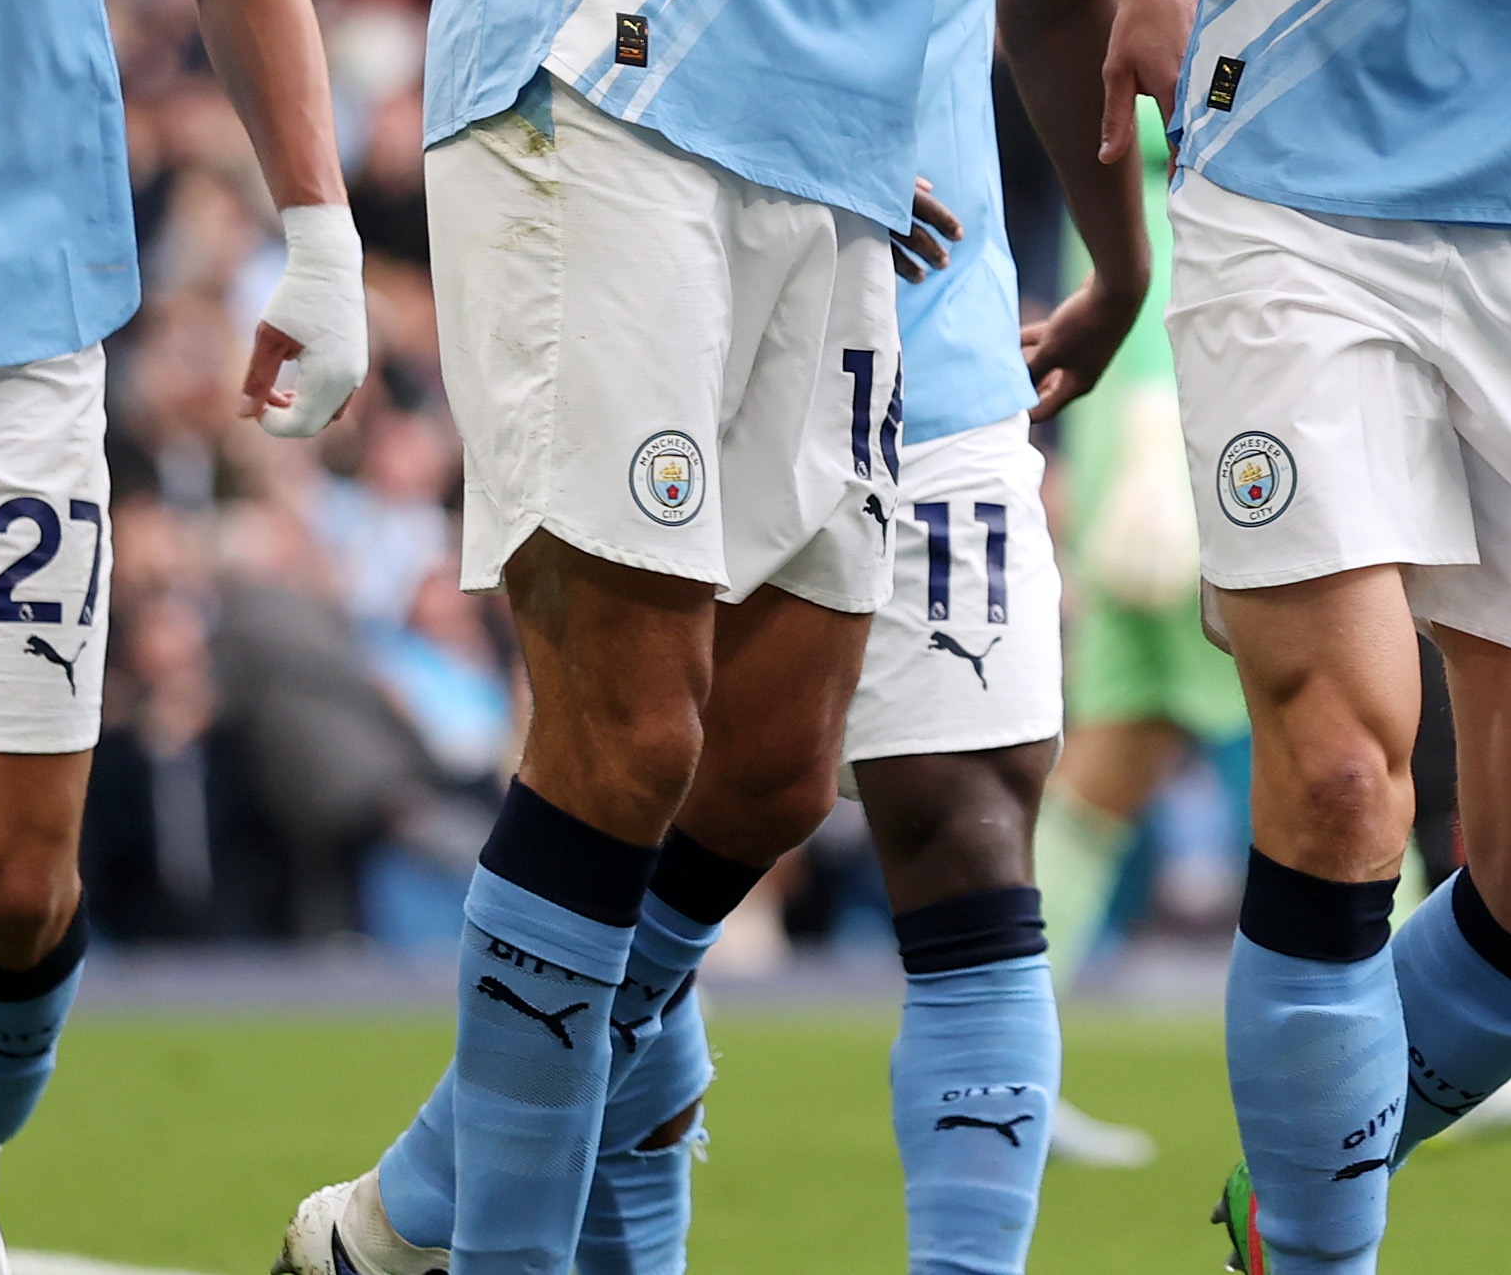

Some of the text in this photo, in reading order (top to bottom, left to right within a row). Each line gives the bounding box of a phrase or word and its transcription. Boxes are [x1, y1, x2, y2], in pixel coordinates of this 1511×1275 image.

[639, 438, 699, 467] MANCHESTER
[1222, 438, 1282, 479] MANCHESTER
[661, 510, 685, 519] CITY
[1249, 505, 1273, 521] CITY
[913, 501, 1008, 625] 11
